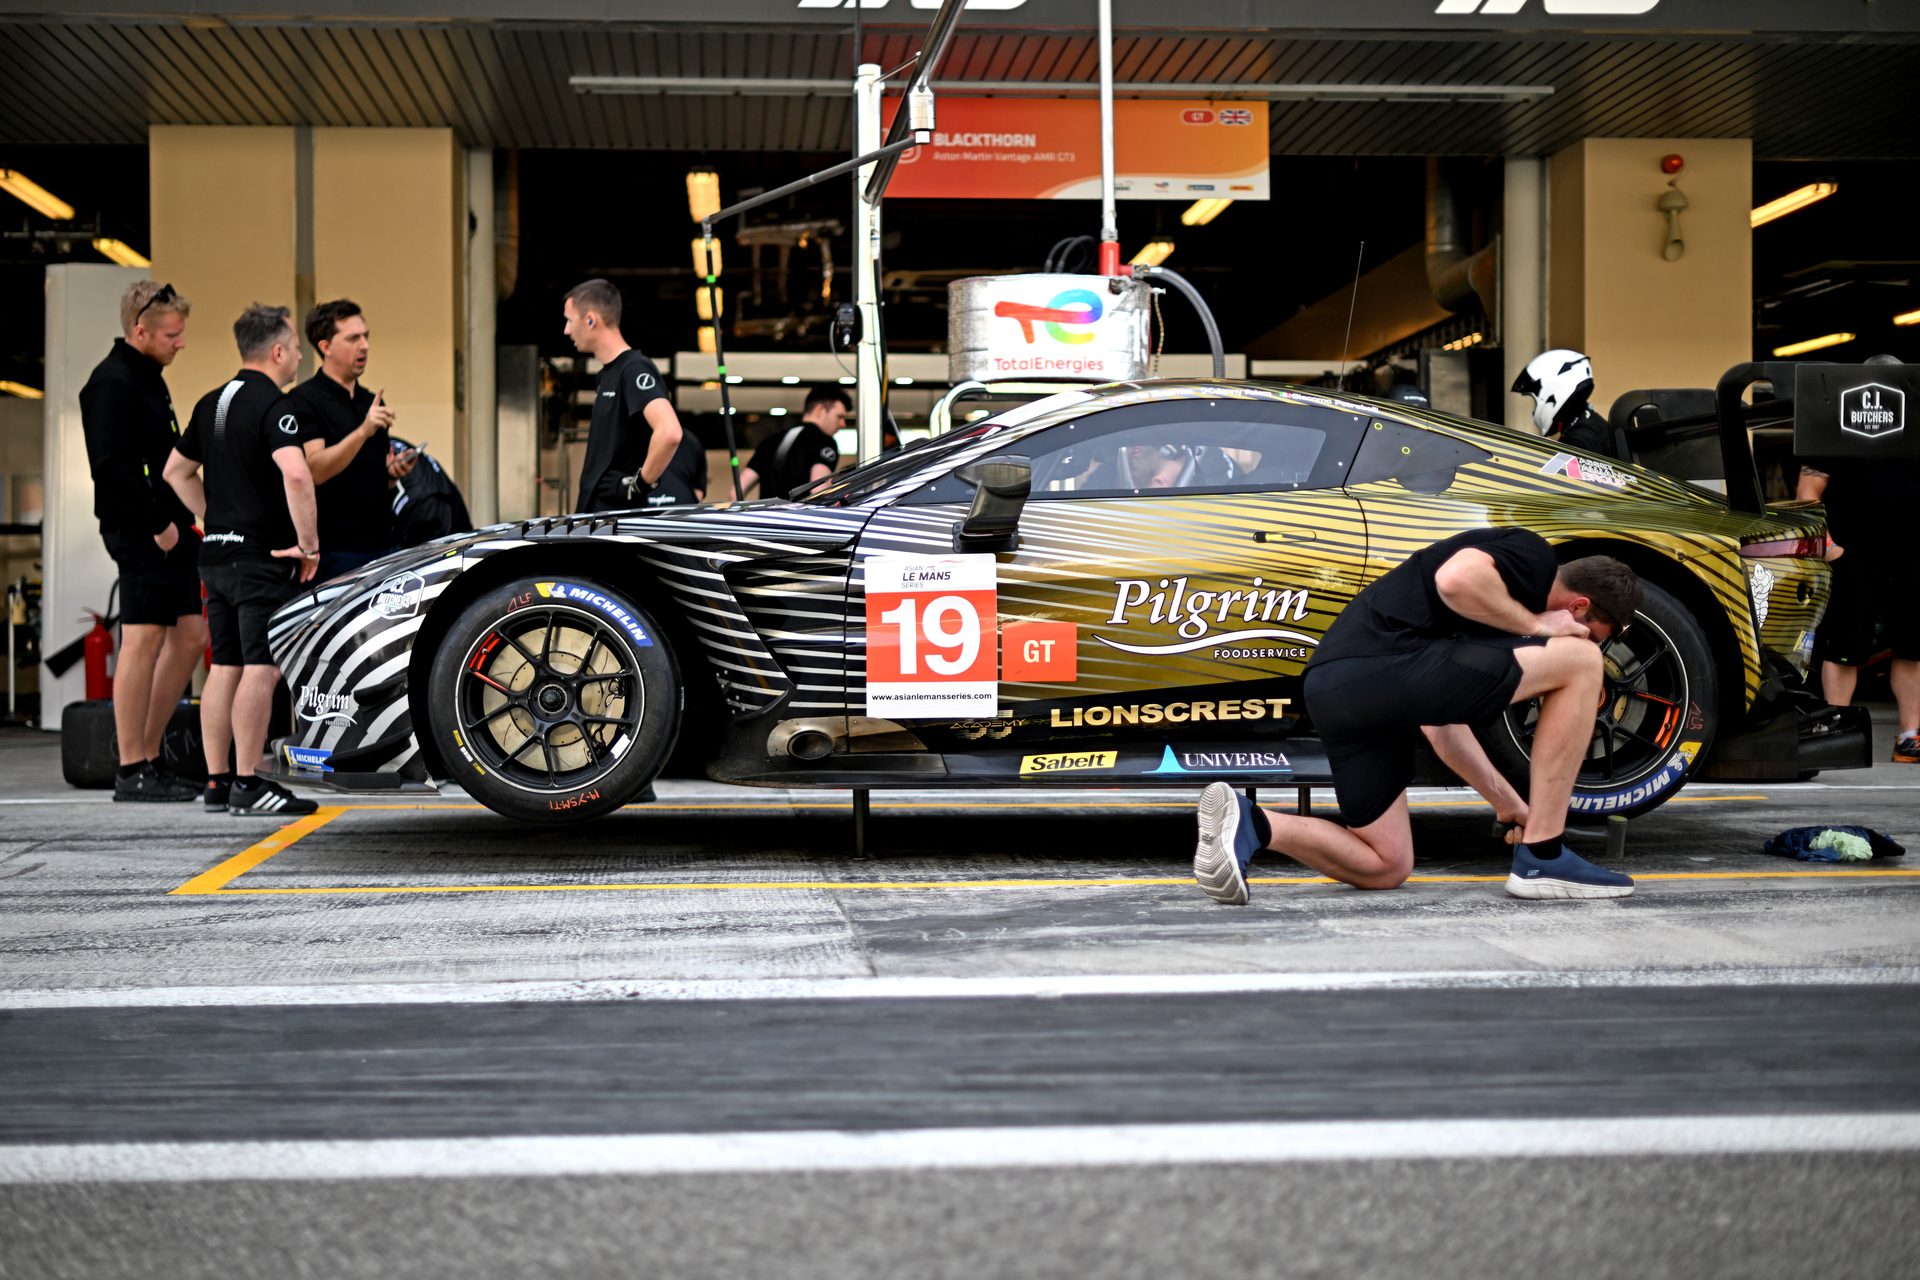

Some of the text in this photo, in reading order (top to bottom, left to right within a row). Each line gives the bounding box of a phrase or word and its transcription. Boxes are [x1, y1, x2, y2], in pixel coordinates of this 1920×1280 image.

[933, 133, 1037, 148] BLACKTHORN
[962, 151, 993, 161] Martin
[993, 357, 1104, 373] TotalEnergies
[1862, 391, 1883, 409] C.J.
[1851, 411, 1894, 423] BUTCHERS
[1582, 471, 1627, 488] GROUP
[902, 571, 951, 581] LE MANS
[901, 581, 924, 589] SERIES
[569, 587, 647, 641] MICHELIN
[1105, 576, 1310, 640] Pilgrim
[881, 595, 981, 676] 19
[1023, 639, 1056, 664] GT
[1213, 647, 1307, 660] FOODSERVICE
[300, 685, 350, 715] Pilgrim
[872, 692, 992, 701] www.asianlemansseries.com
[1050, 698, 1292, 728] LIONSCREST
[949, 718, 1027, 729] ACADEMY
[1030, 753, 1107, 771] Sabelt
[1183, 752, 1291, 768] UNIVERSA
[1569, 770, 1671, 810] MICHELIN
